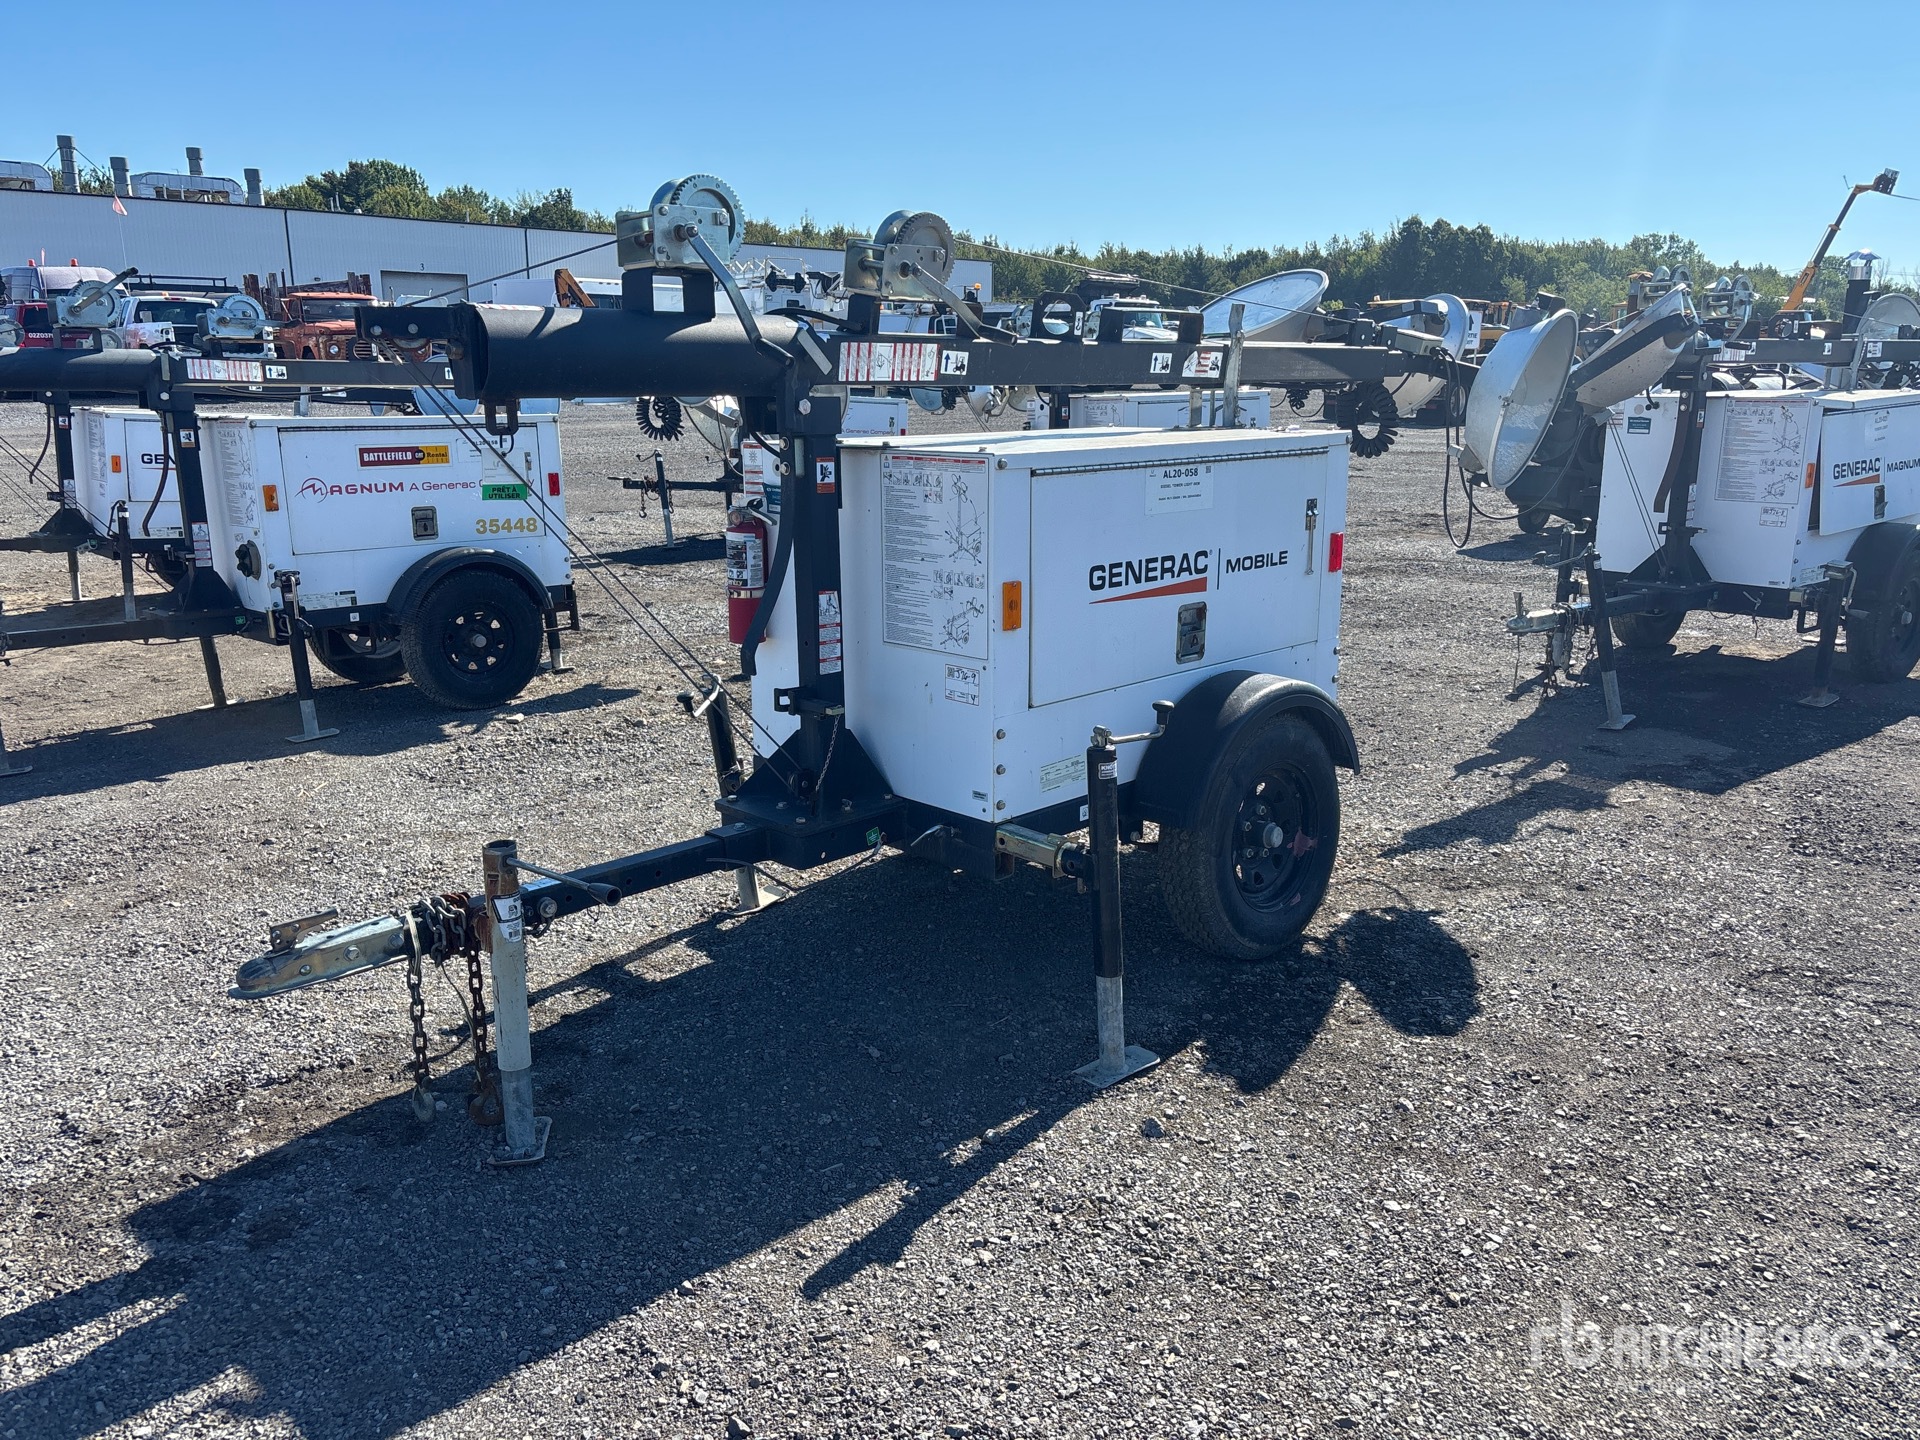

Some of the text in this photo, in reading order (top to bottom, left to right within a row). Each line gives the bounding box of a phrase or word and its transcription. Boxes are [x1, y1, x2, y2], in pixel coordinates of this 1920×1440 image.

[420, 263, 425, 271] 3
[363, 452, 413, 462] BATTLEFIELD
[1163, 468, 1198, 479] AL20-058
[1833, 457, 1920, 480] GENERAC MAGNUM
[409, 482, 420, 492] A
[421, 479, 477, 491] Generac
[492, 485, 510, 493] PRÊT
[475, 517, 538, 535] 35448
[1088, 550, 1288, 591] GENERAC MOBILE
